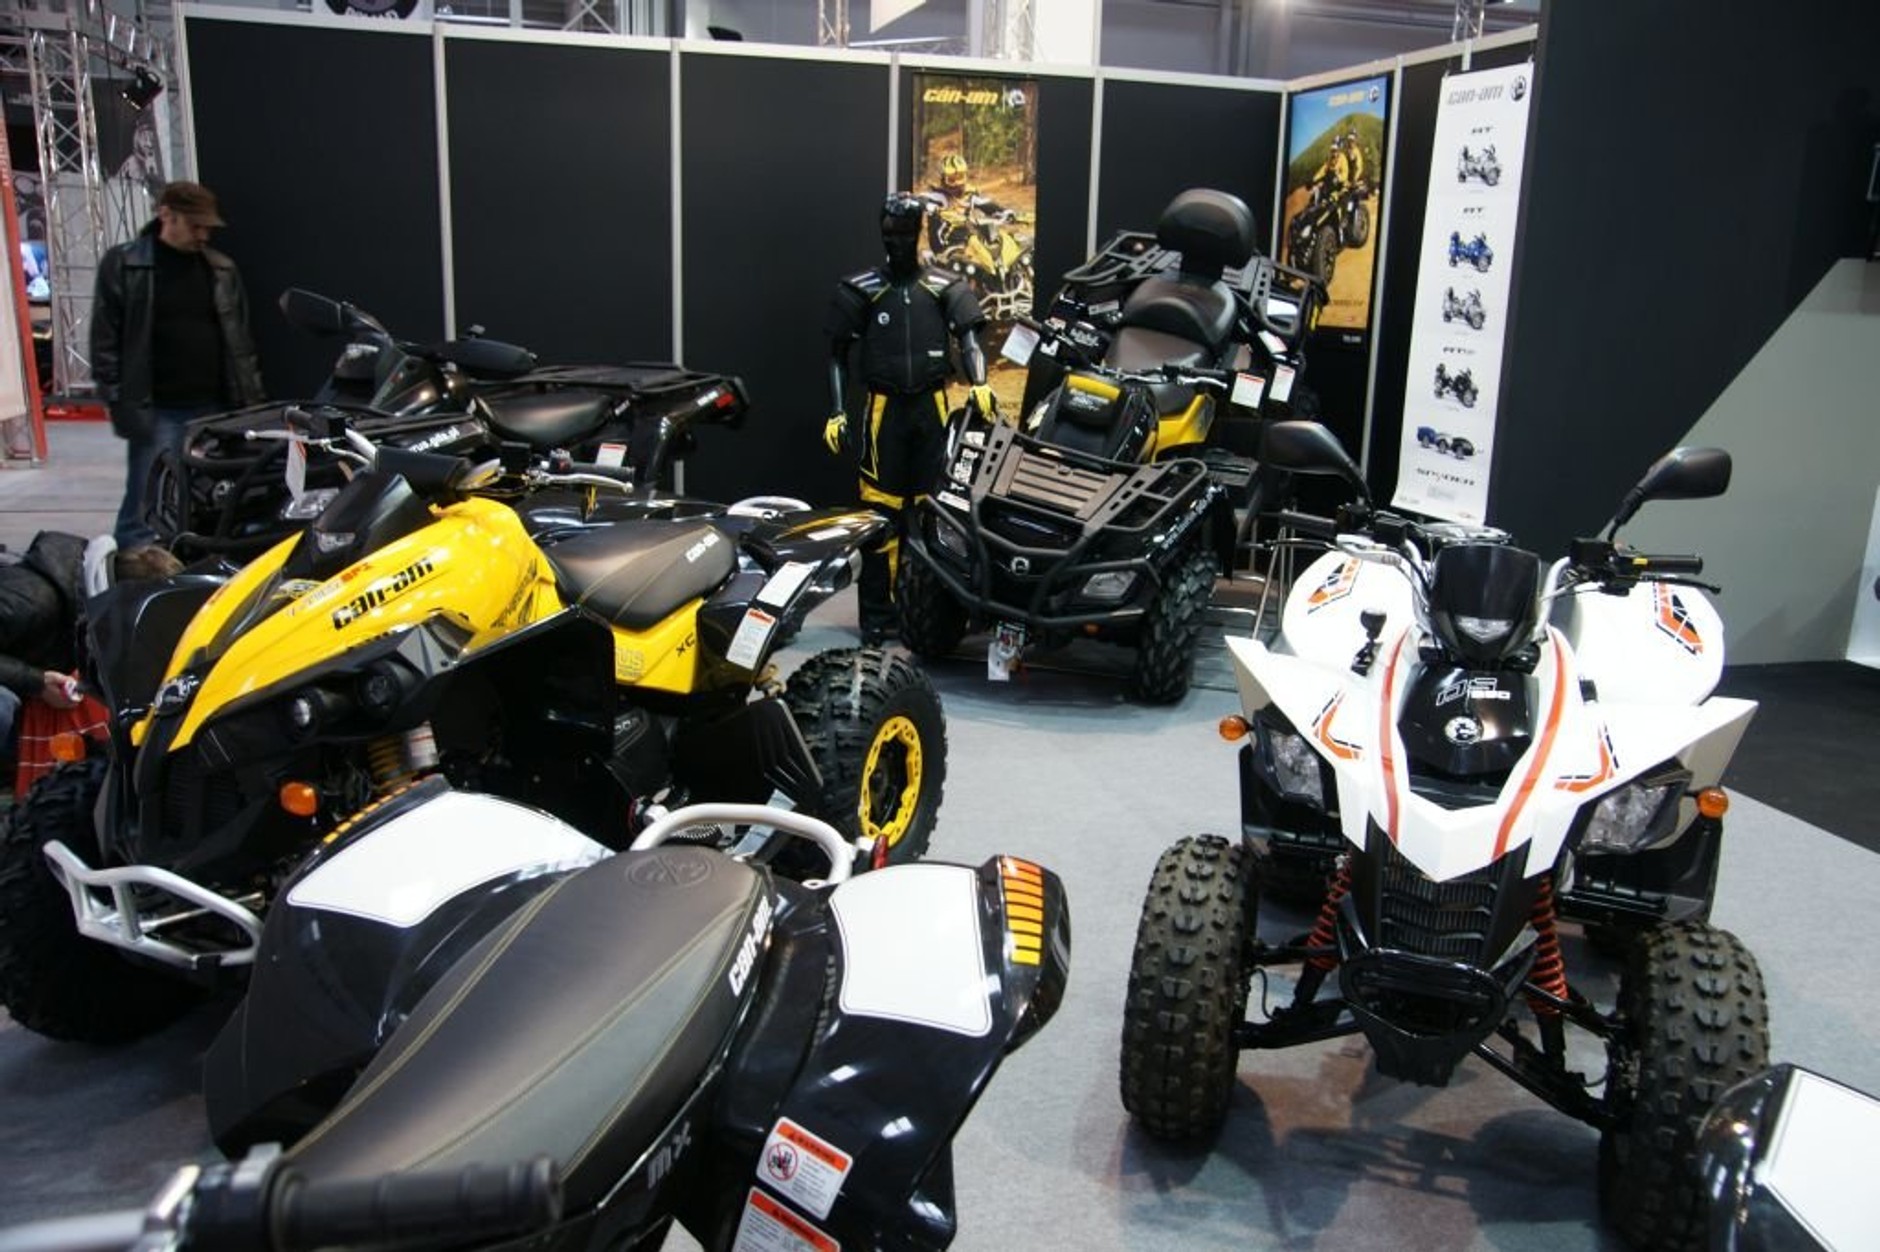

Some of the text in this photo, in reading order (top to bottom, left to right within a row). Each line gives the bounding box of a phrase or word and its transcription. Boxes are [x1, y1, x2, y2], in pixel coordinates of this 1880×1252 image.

[923, 88, 999, 105] can-am
[1448, 85, 1504, 105] can-am
[332, 557, 434, 630] can-am
